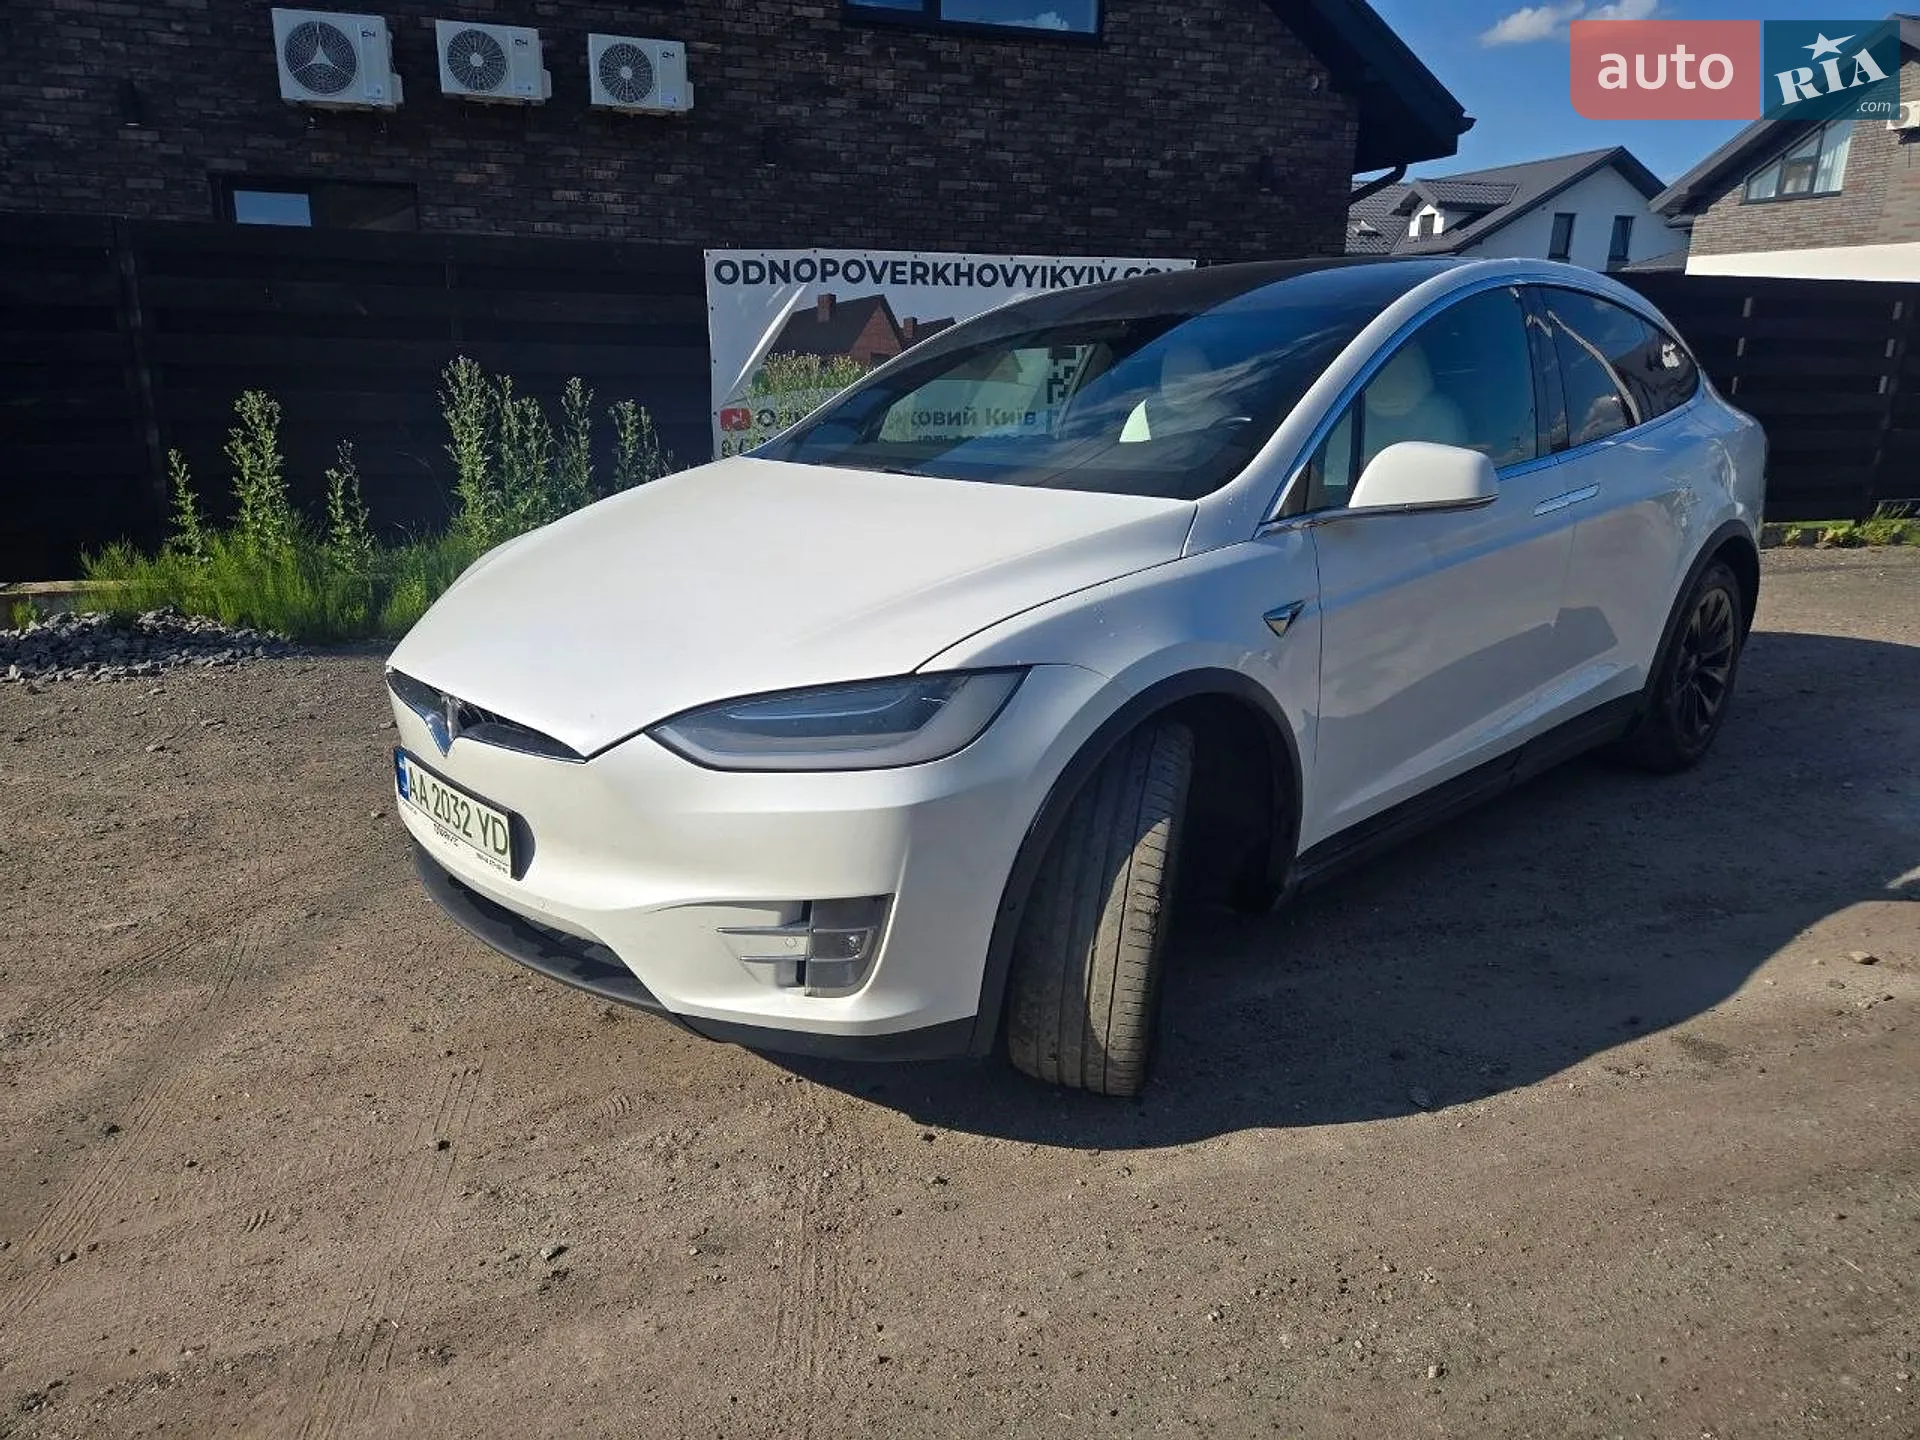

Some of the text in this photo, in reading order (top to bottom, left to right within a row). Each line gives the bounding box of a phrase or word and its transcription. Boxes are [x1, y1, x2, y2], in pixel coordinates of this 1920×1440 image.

[713, 257, 1173, 289] ODNOPOVERKHOVYIKYIV
[409, 766, 430, 811] AA
[432, 782, 473, 839] 2032
[476, 806, 509, 856] YD
